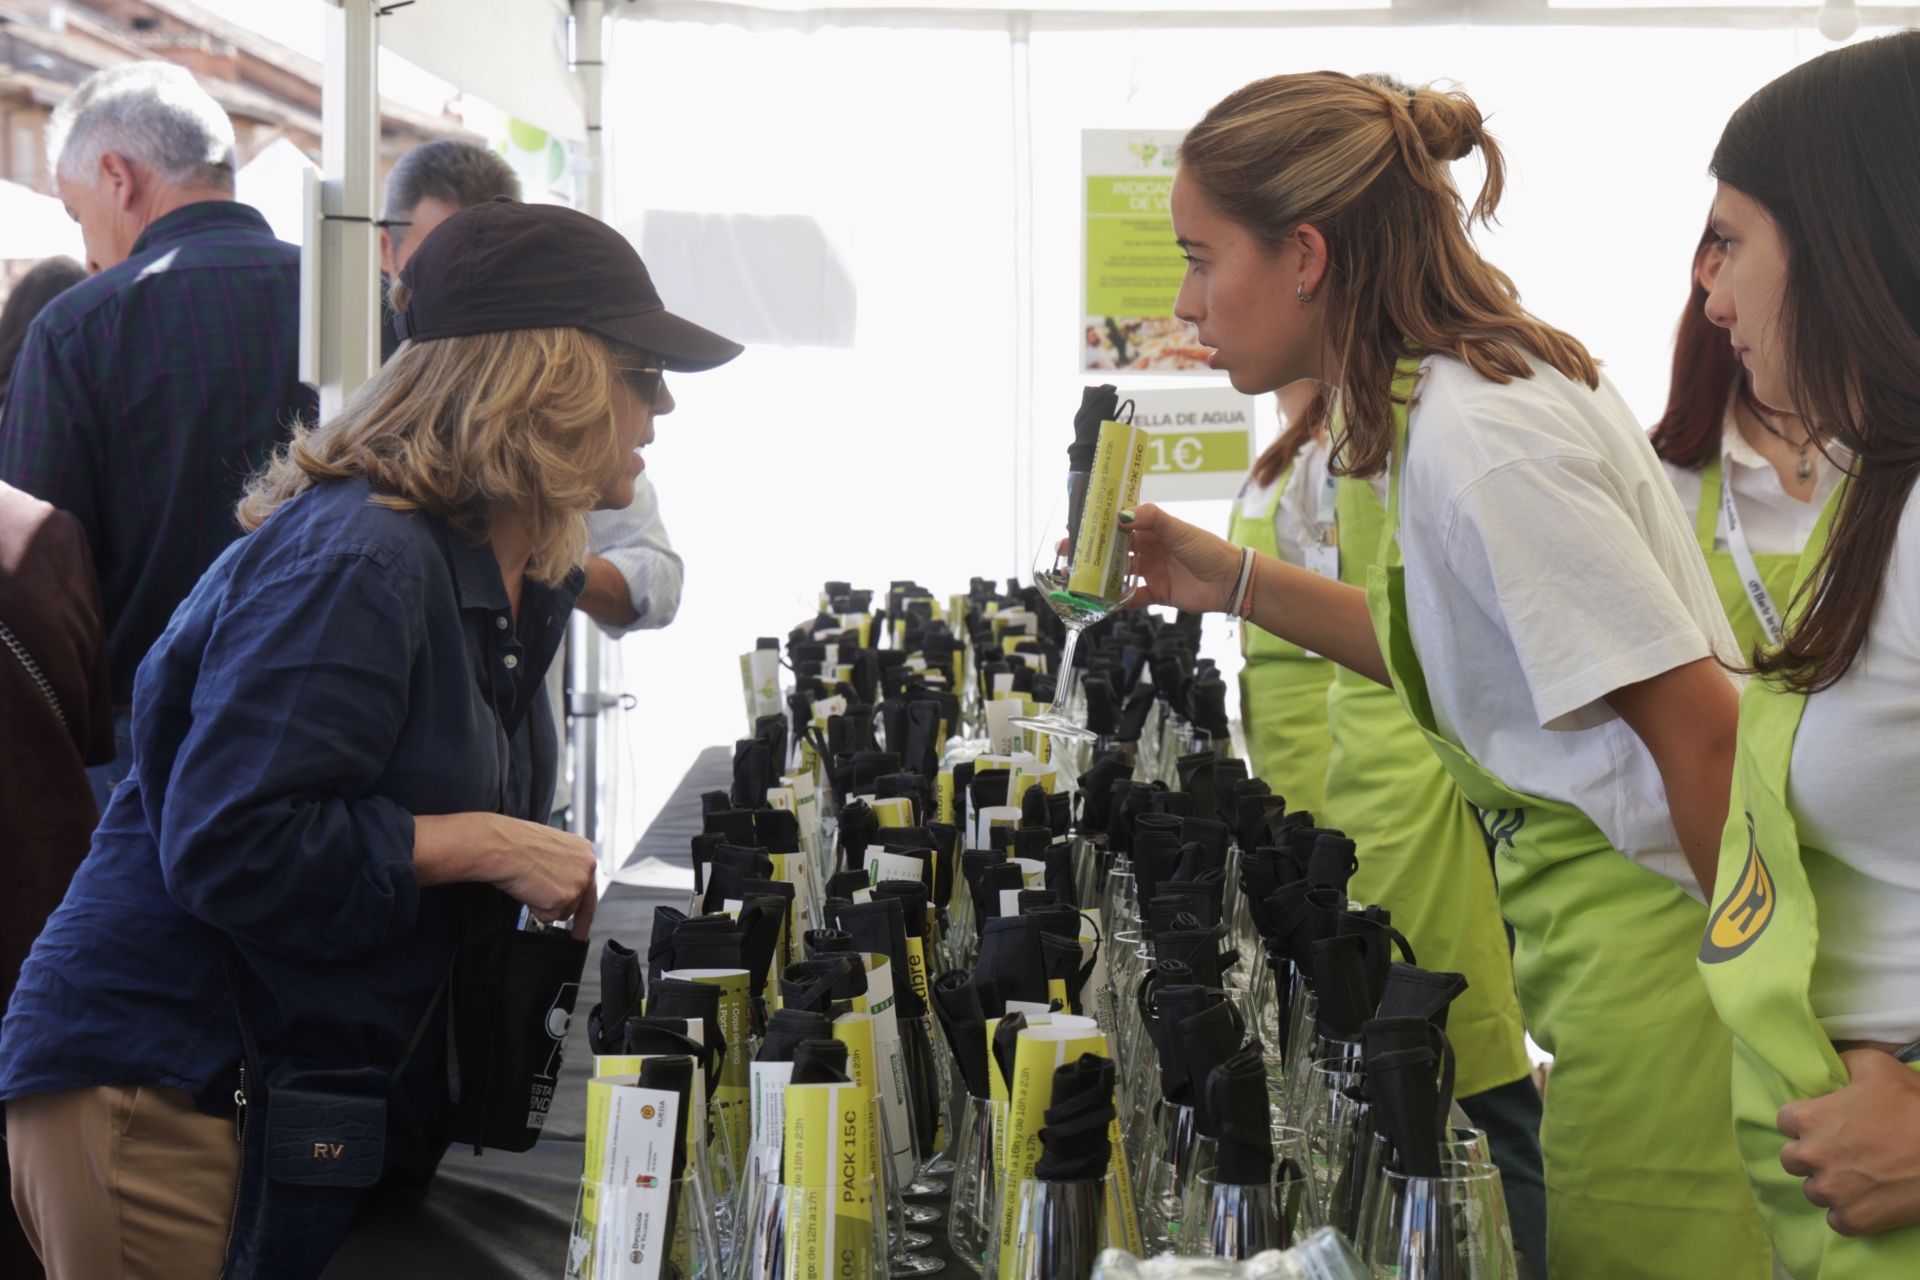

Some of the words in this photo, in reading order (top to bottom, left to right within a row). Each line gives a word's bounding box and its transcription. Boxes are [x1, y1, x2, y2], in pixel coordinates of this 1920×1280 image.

[1175, 413, 1197, 426] DE
[1202, 410, 1246, 425] AGUA
[1149, 436, 1205, 472] 1€
[731, 1008, 740, 1032] Copa
[733, 1033, 740, 1044] de
[853, 1049, 861, 1069] 23h
[1019, 1067, 1030, 1088] 23h
[656, 1100, 666, 1128] RUEDA
[1016, 1097, 1026, 1116] 18h
[794, 1118, 804, 1141] 23h
[843, 1110, 857, 1147] 15€
[1014, 1118, 1024, 1131] de
[313, 1142, 345, 1160] RV
[1010, 1140, 1021, 1159] 16h
[1026, 1133, 1036, 1153] 17h
[793, 1151, 803, 1172] 18h
[793, 1173, 802, 1188] de
[843, 1152, 857, 1203] PACK
[807, 1191, 816, 1212] 17h
[1007, 1191, 1016, 1204] de
[808, 1213, 816, 1222] a
[1002, 1204, 1014, 1247] Sábado:
[807, 1223, 817, 1244] 12h
[807, 1246, 816, 1261] de
[841, 1249, 855, 1280] 0€
